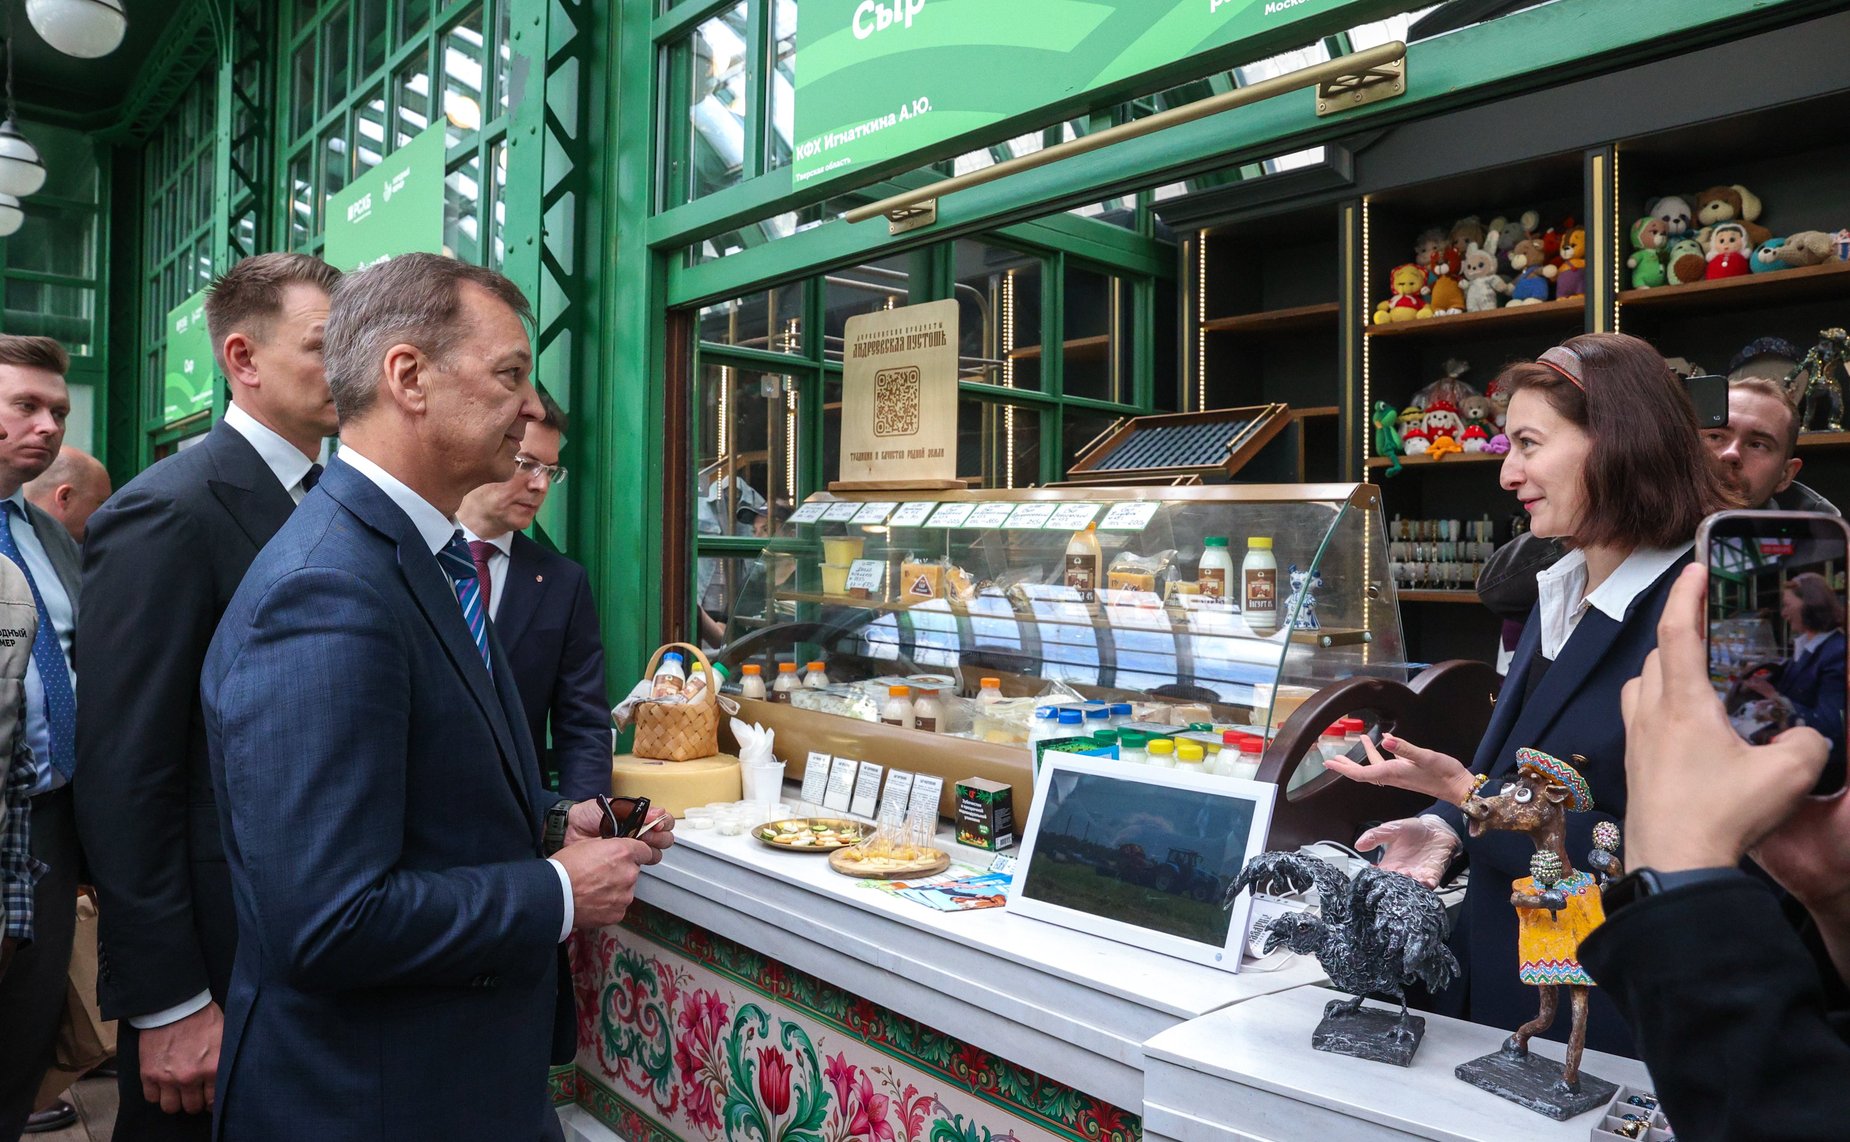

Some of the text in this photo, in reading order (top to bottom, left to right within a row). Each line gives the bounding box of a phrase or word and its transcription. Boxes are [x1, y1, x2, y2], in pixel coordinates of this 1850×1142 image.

[852, 0, 926, 40] Сыр
[1264, 0, 1309, 16] Моск
[796, 96, 933, 161] КФХ Игнаткина А.Ю.
[825, 157, 851, 171] область
